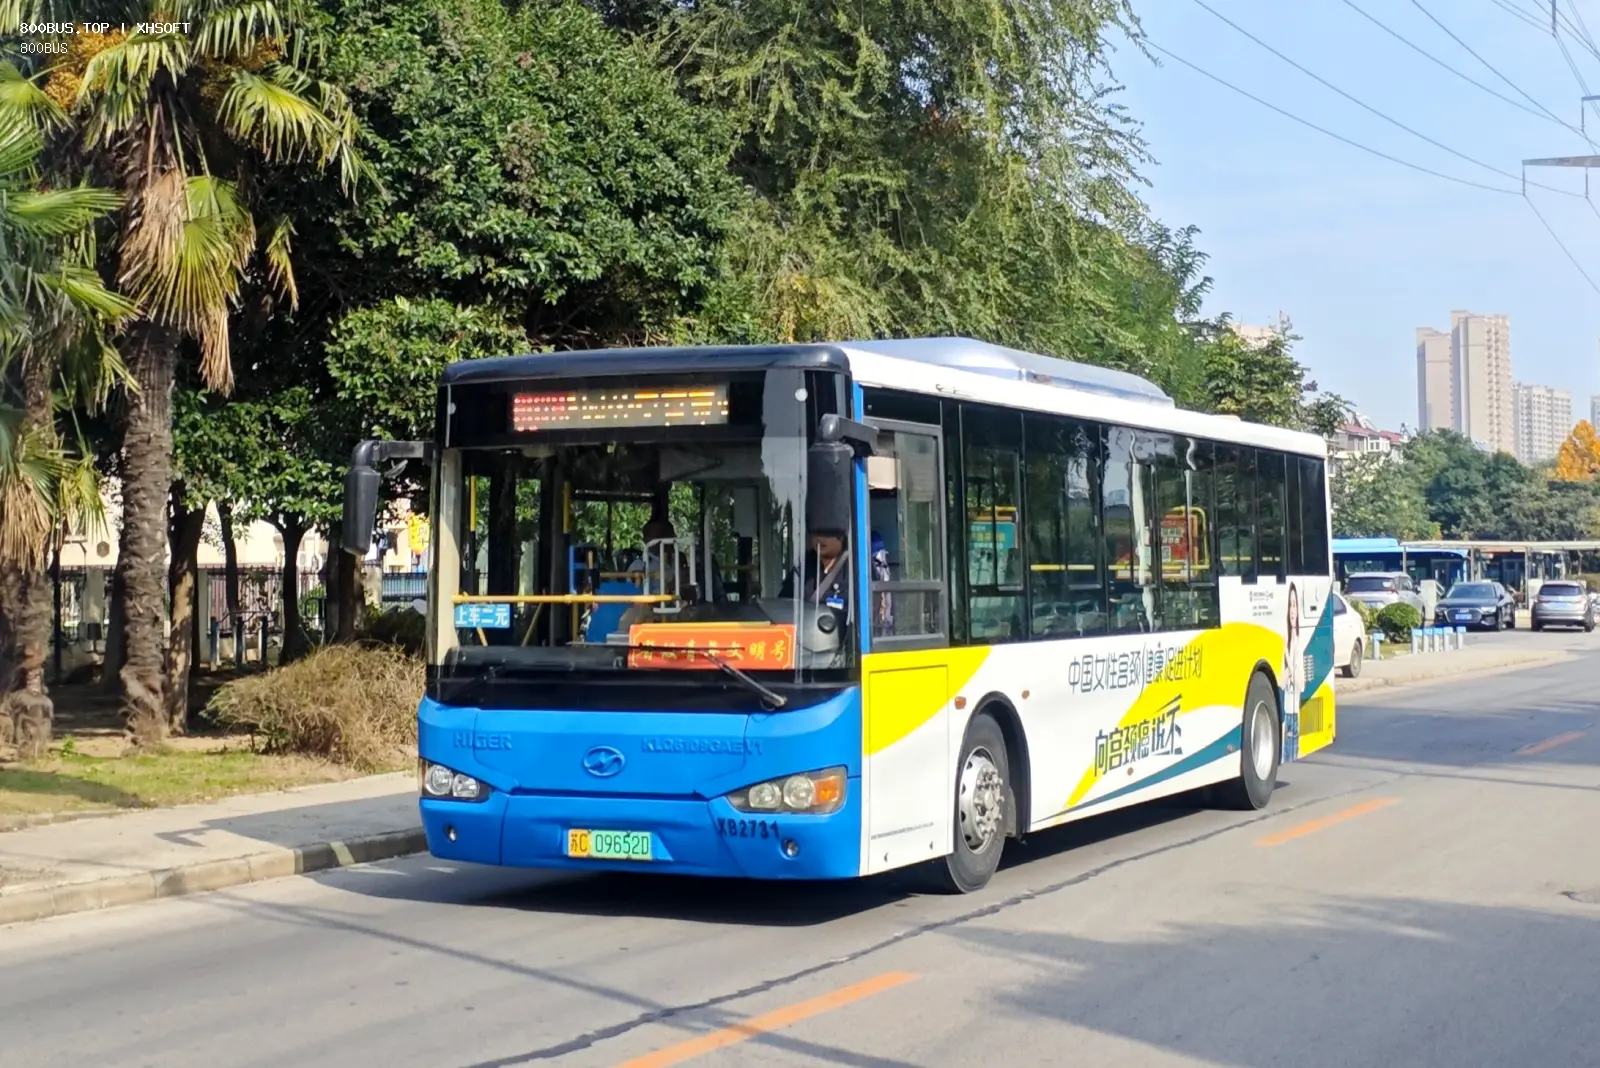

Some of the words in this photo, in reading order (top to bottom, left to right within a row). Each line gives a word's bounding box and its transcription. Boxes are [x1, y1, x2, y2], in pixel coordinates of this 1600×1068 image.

[455, 606, 509, 627] 上车二元
[1067, 641, 1203, 697] 中国女性宫颈健康促进计划
[453, 731, 513, 750] HIGER
[1093, 692, 1183, 777] 向宫颈癌说不
[717, 816, 780, 840] XB2731
